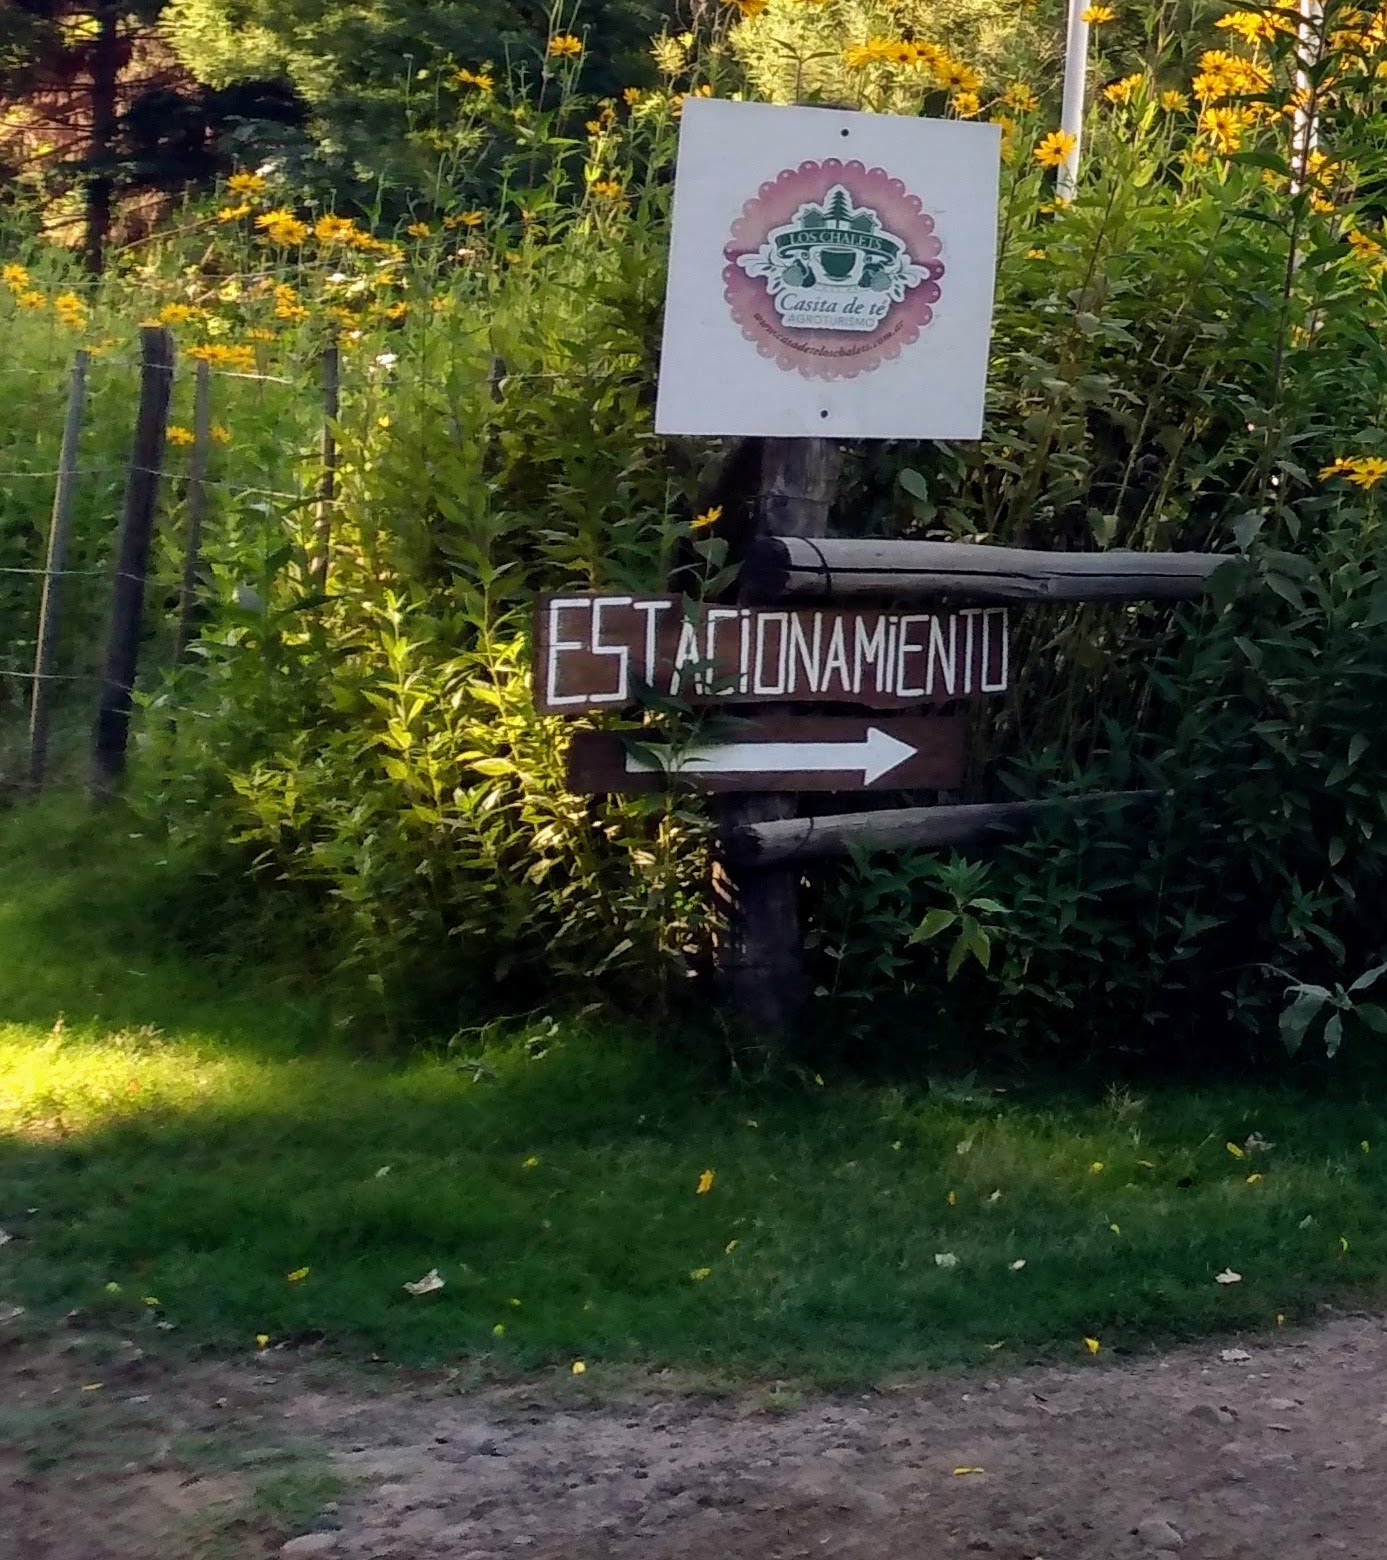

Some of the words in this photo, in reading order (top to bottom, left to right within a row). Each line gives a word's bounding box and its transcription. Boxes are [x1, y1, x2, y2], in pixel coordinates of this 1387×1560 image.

[789, 231, 817, 245] LOS
[819, 231, 882, 250] CHALETS
[780, 293, 838, 313] Casita
[842, 296, 865, 315] de
[868, 299, 888, 316] té
[788, 314, 876, 328] AGROTURISMO
